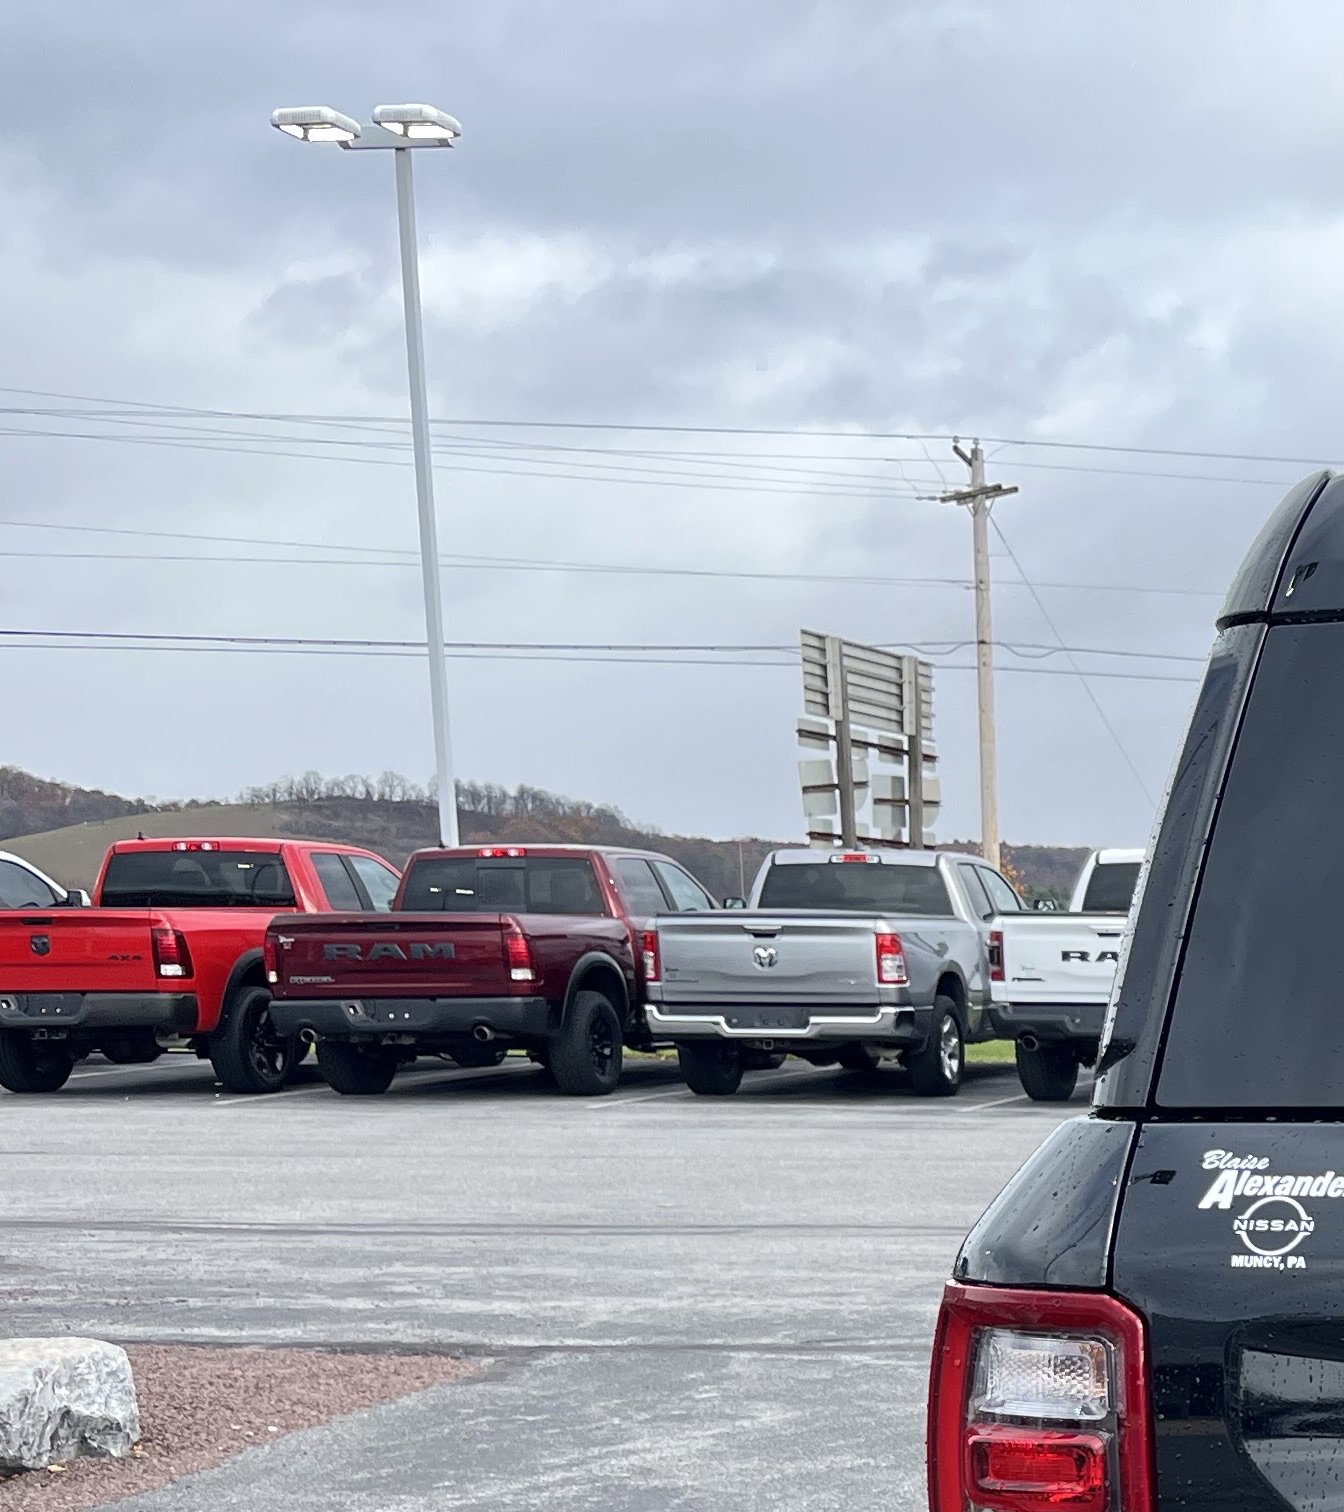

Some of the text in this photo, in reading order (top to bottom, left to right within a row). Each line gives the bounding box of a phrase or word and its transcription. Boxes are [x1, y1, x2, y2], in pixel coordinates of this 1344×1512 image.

[323, 943, 457, 961] RAM
[1061, 950, 1119, 962] RA
[1202, 1149, 1270, 1170] Blaise
[1233, 1219, 1315, 1232] NISSAN
[1231, 1255, 1307, 1270] MUNCY, PA
